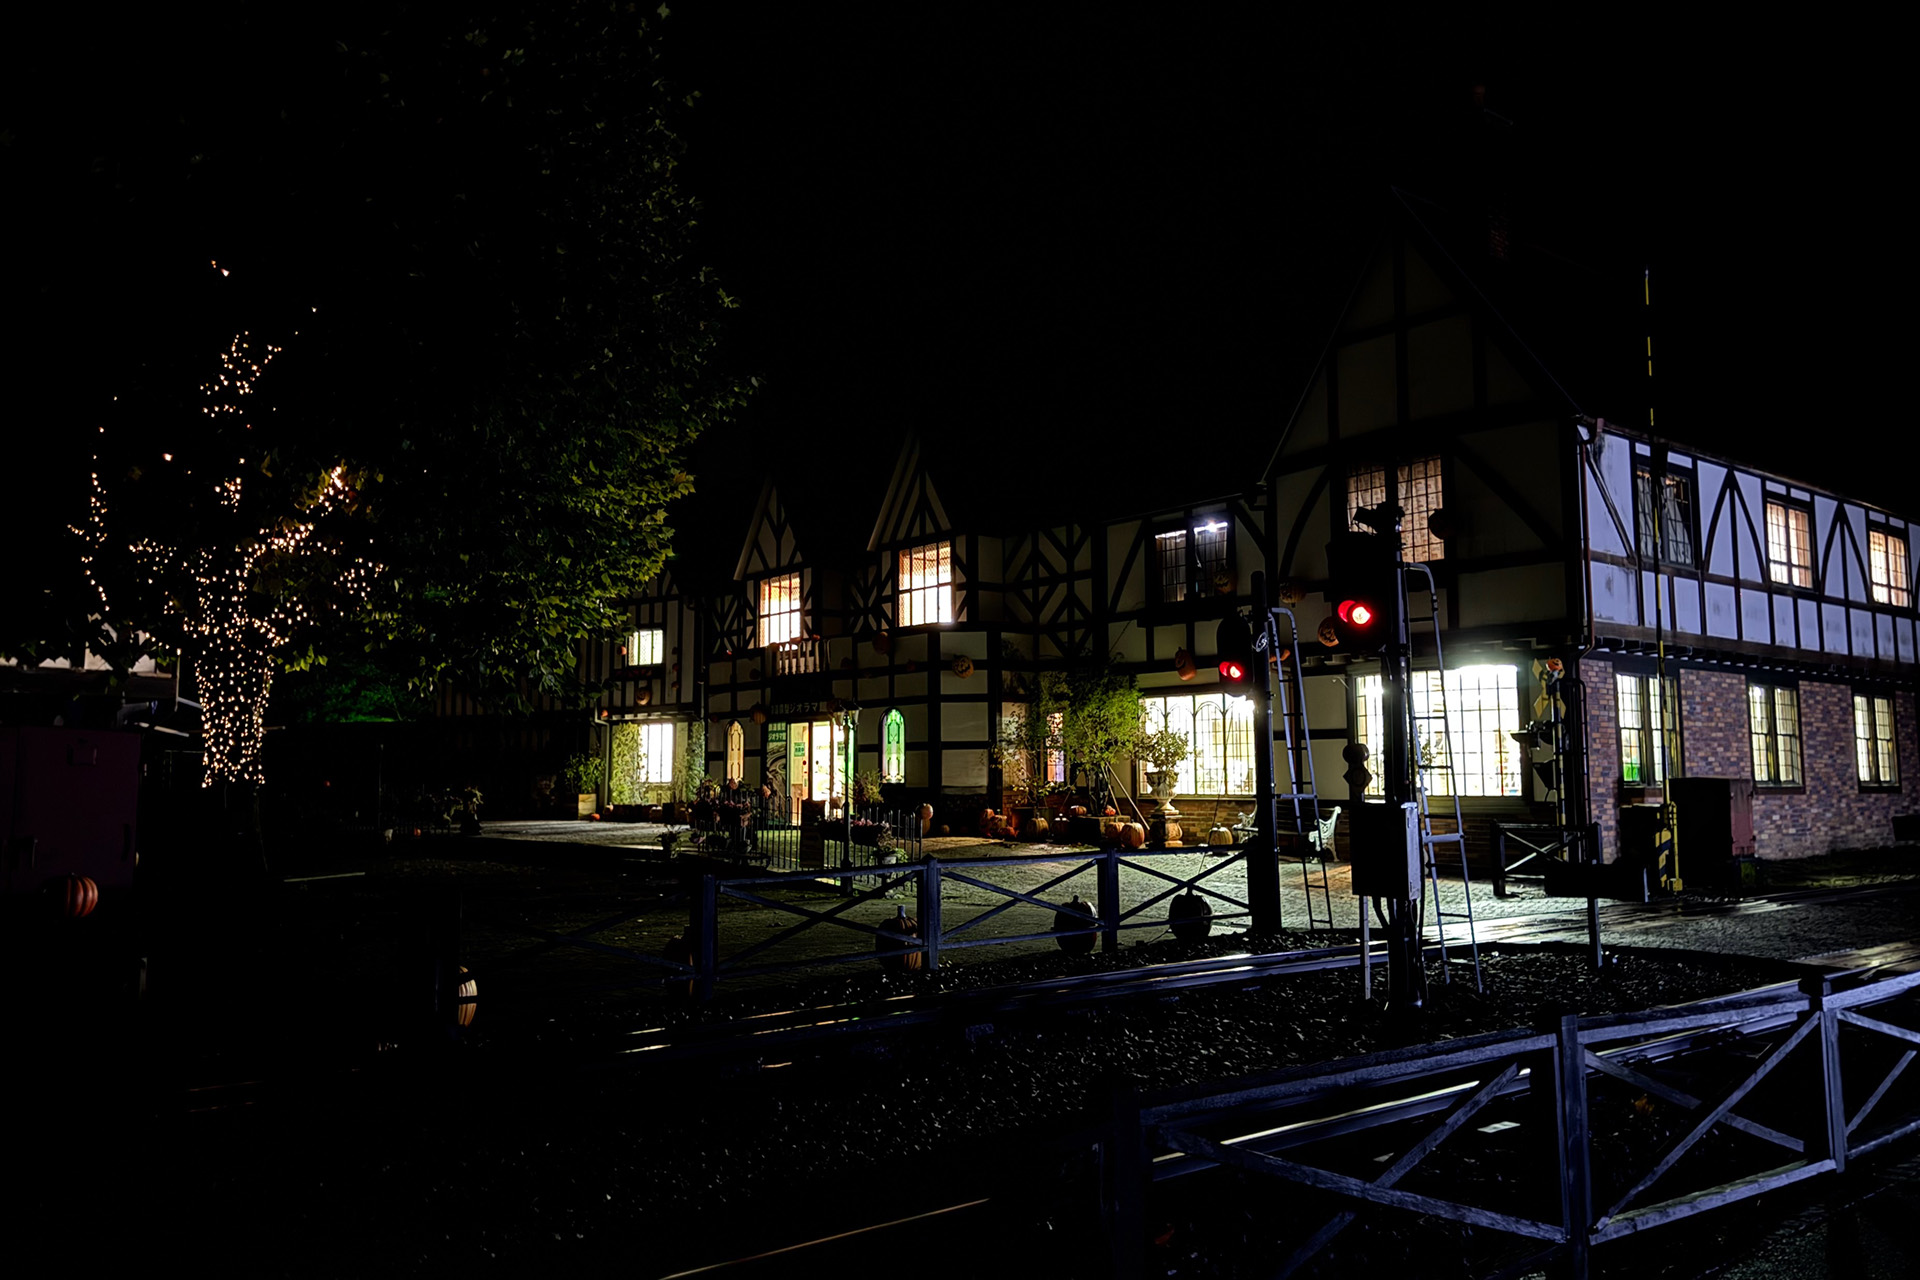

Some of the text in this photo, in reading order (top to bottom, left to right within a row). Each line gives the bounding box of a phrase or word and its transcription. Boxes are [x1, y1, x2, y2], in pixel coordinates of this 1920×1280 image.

[771, 701, 827, 715] 型ジオラマ
[768, 732, 786, 741] ジオラマ
